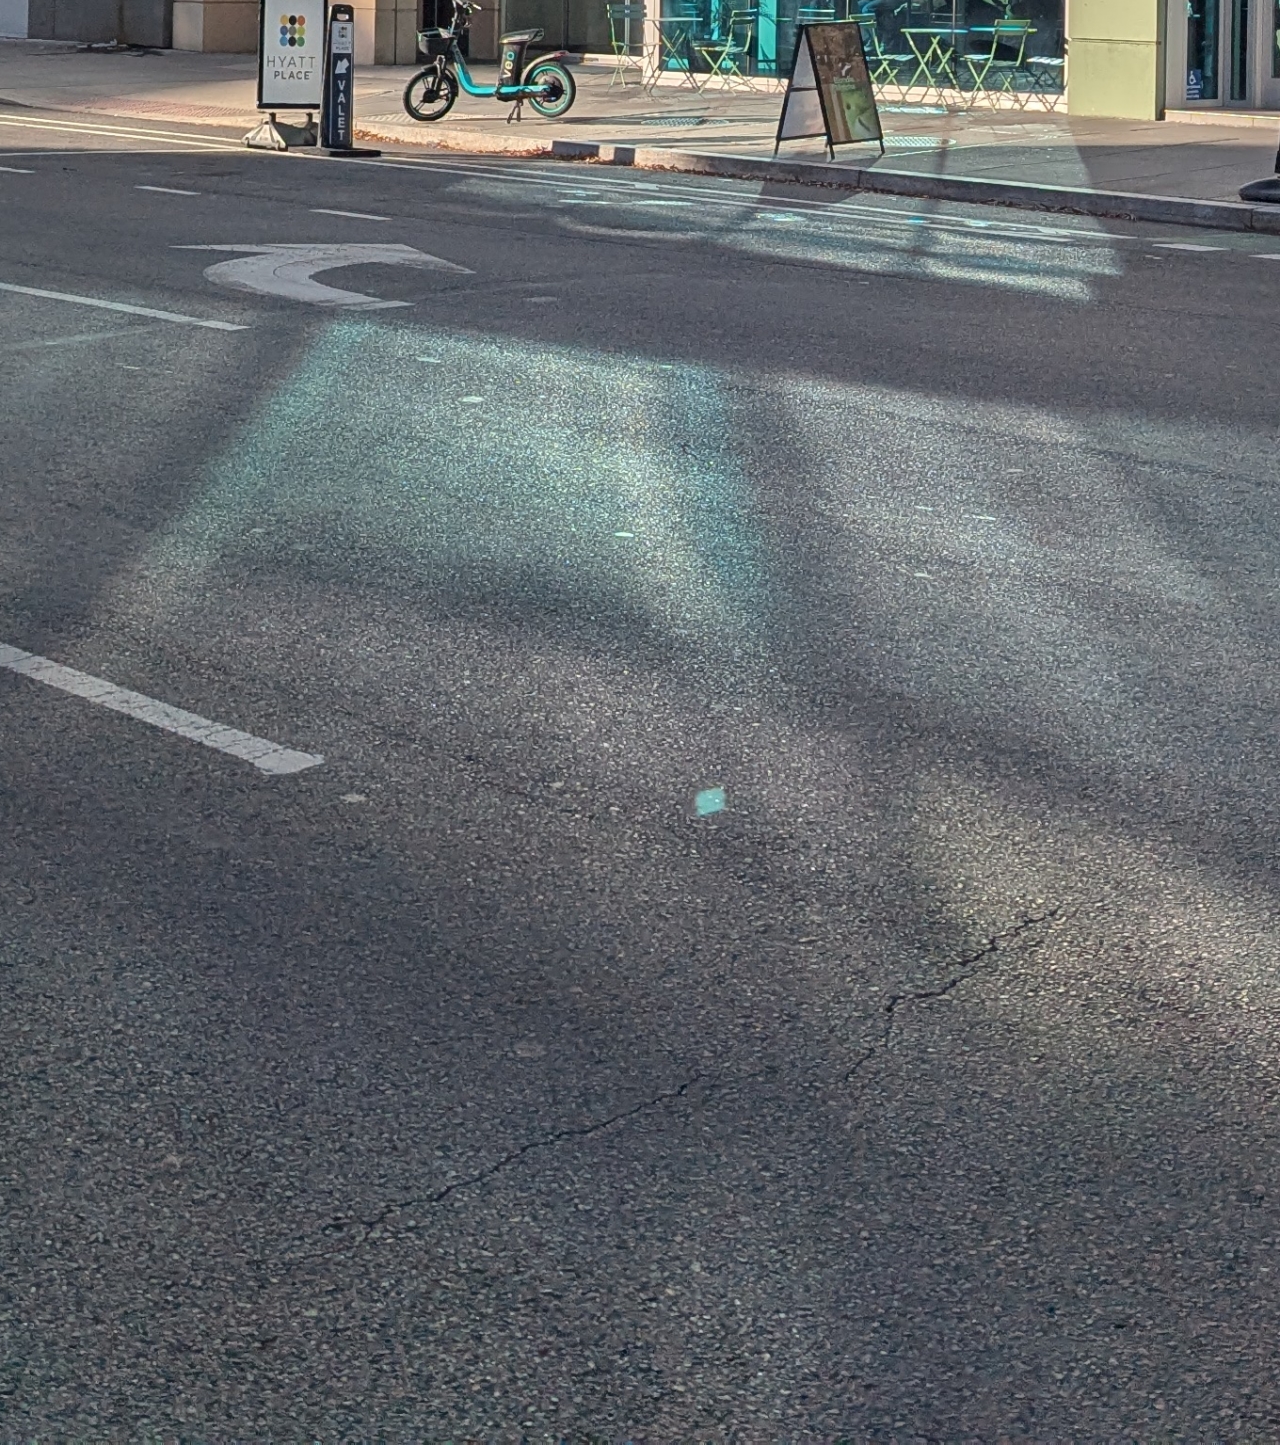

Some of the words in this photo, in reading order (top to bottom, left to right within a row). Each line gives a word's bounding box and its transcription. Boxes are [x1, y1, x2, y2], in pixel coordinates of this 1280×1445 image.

[266, 56, 316, 68] HYATT
[503, 51, 515, 78] veo
[273, 70, 311, 81] PLACE
[337, 80, 347, 141] VALET
